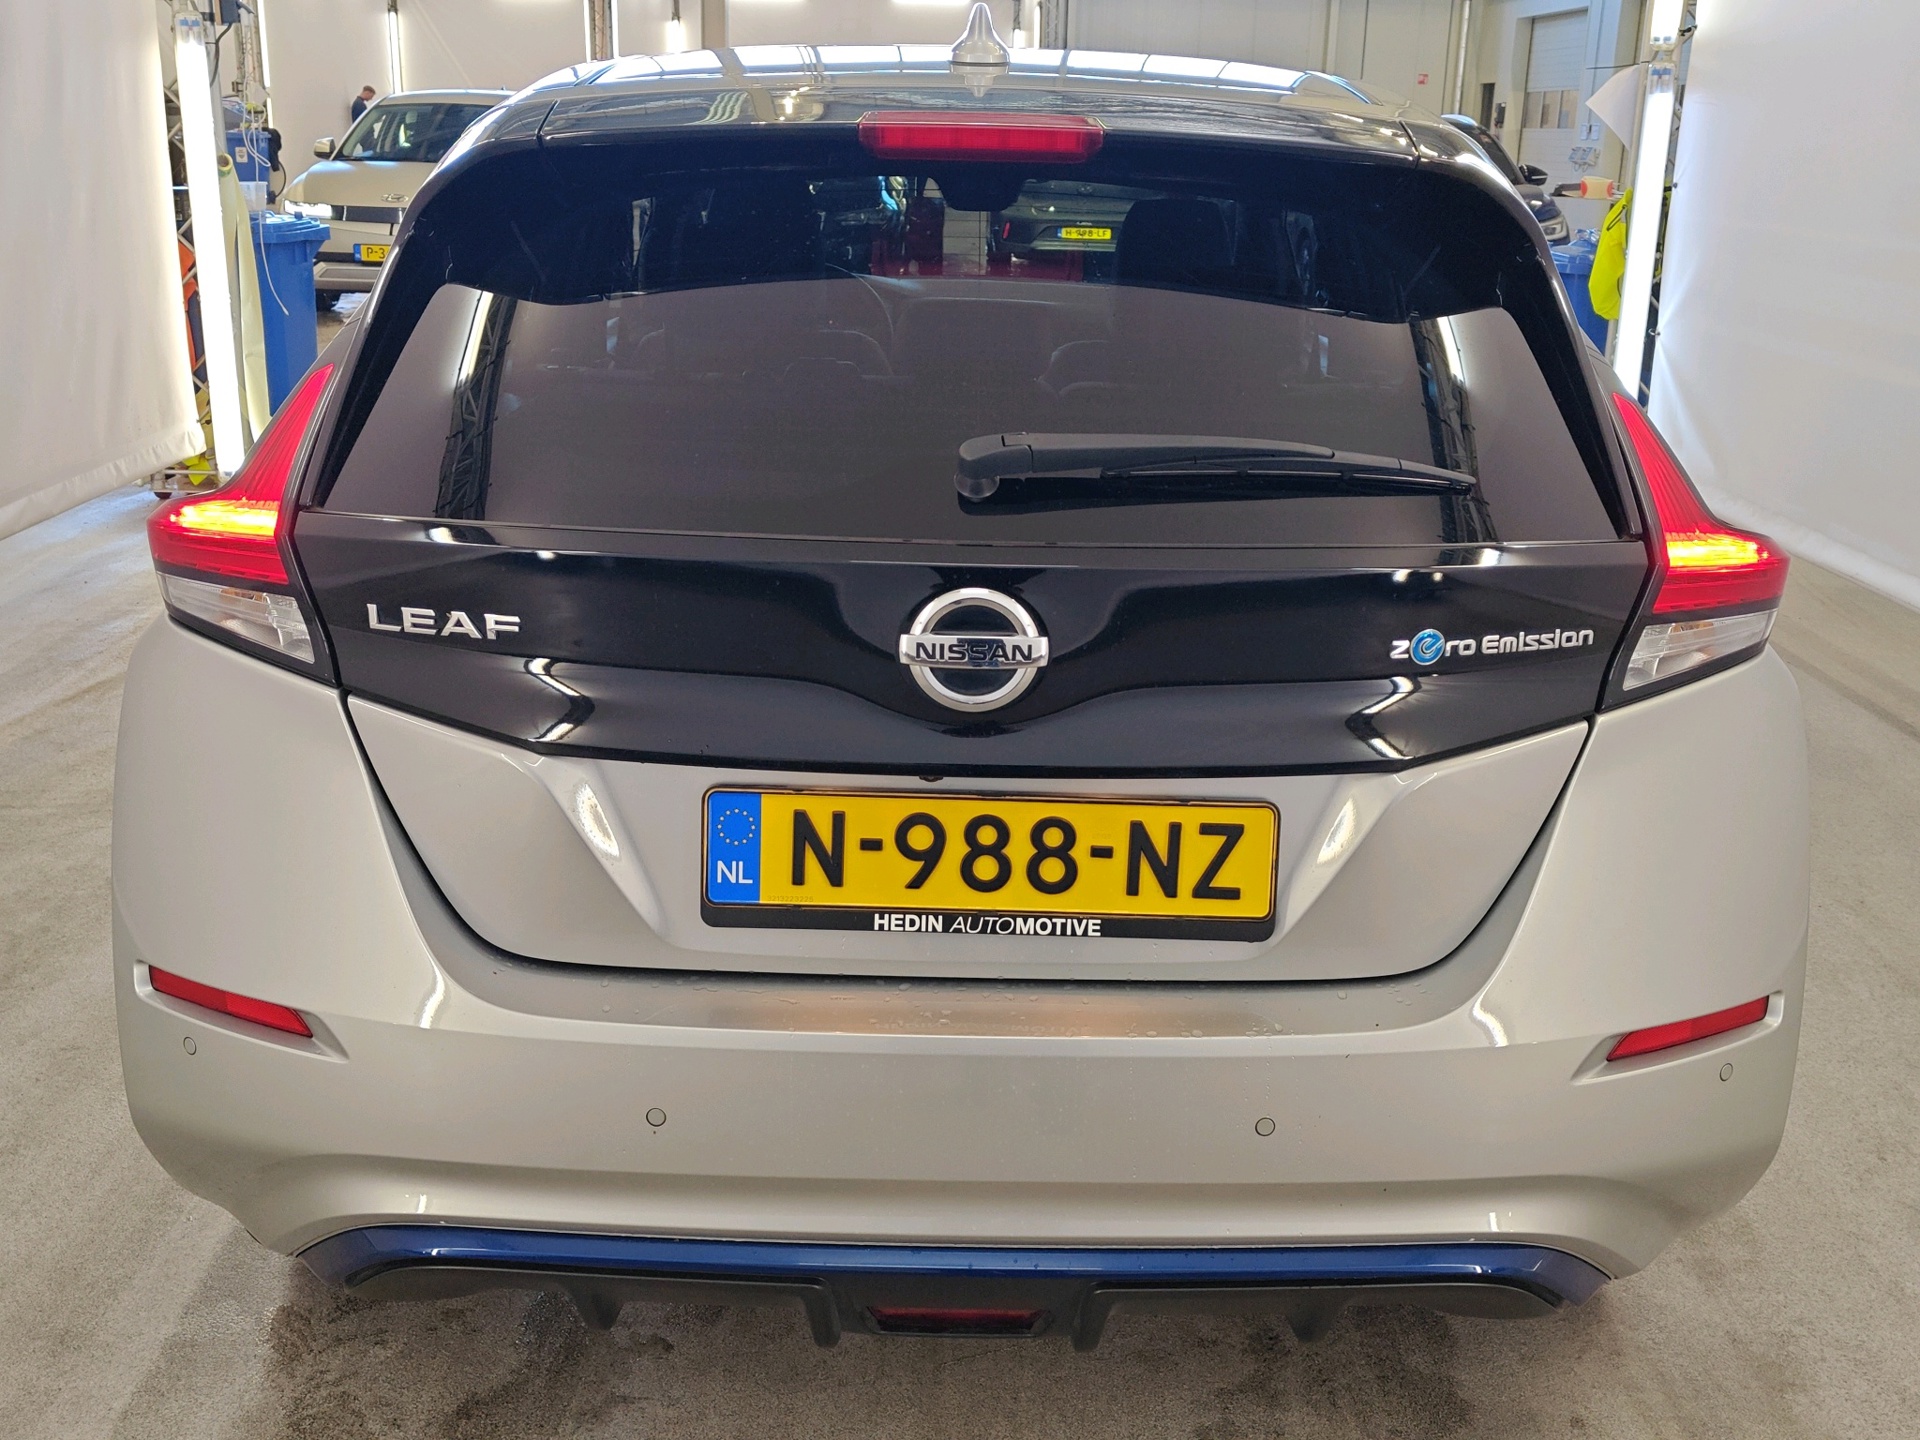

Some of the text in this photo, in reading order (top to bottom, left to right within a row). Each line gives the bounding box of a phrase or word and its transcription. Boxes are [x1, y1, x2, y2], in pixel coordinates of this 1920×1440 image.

[366, 246, 388, 259] P-3
[366, 603, 521, 640] LEAF
[915, 641, 1033, 662] NISSAN
[1389, 628, 1594, 666] zero Emission
[791, 808, 1246, 901] N-988-NZ
[716, 860, 754, 885] NL
[873, 913, 1102, 937] HEDIN AUTOMOTIVE
